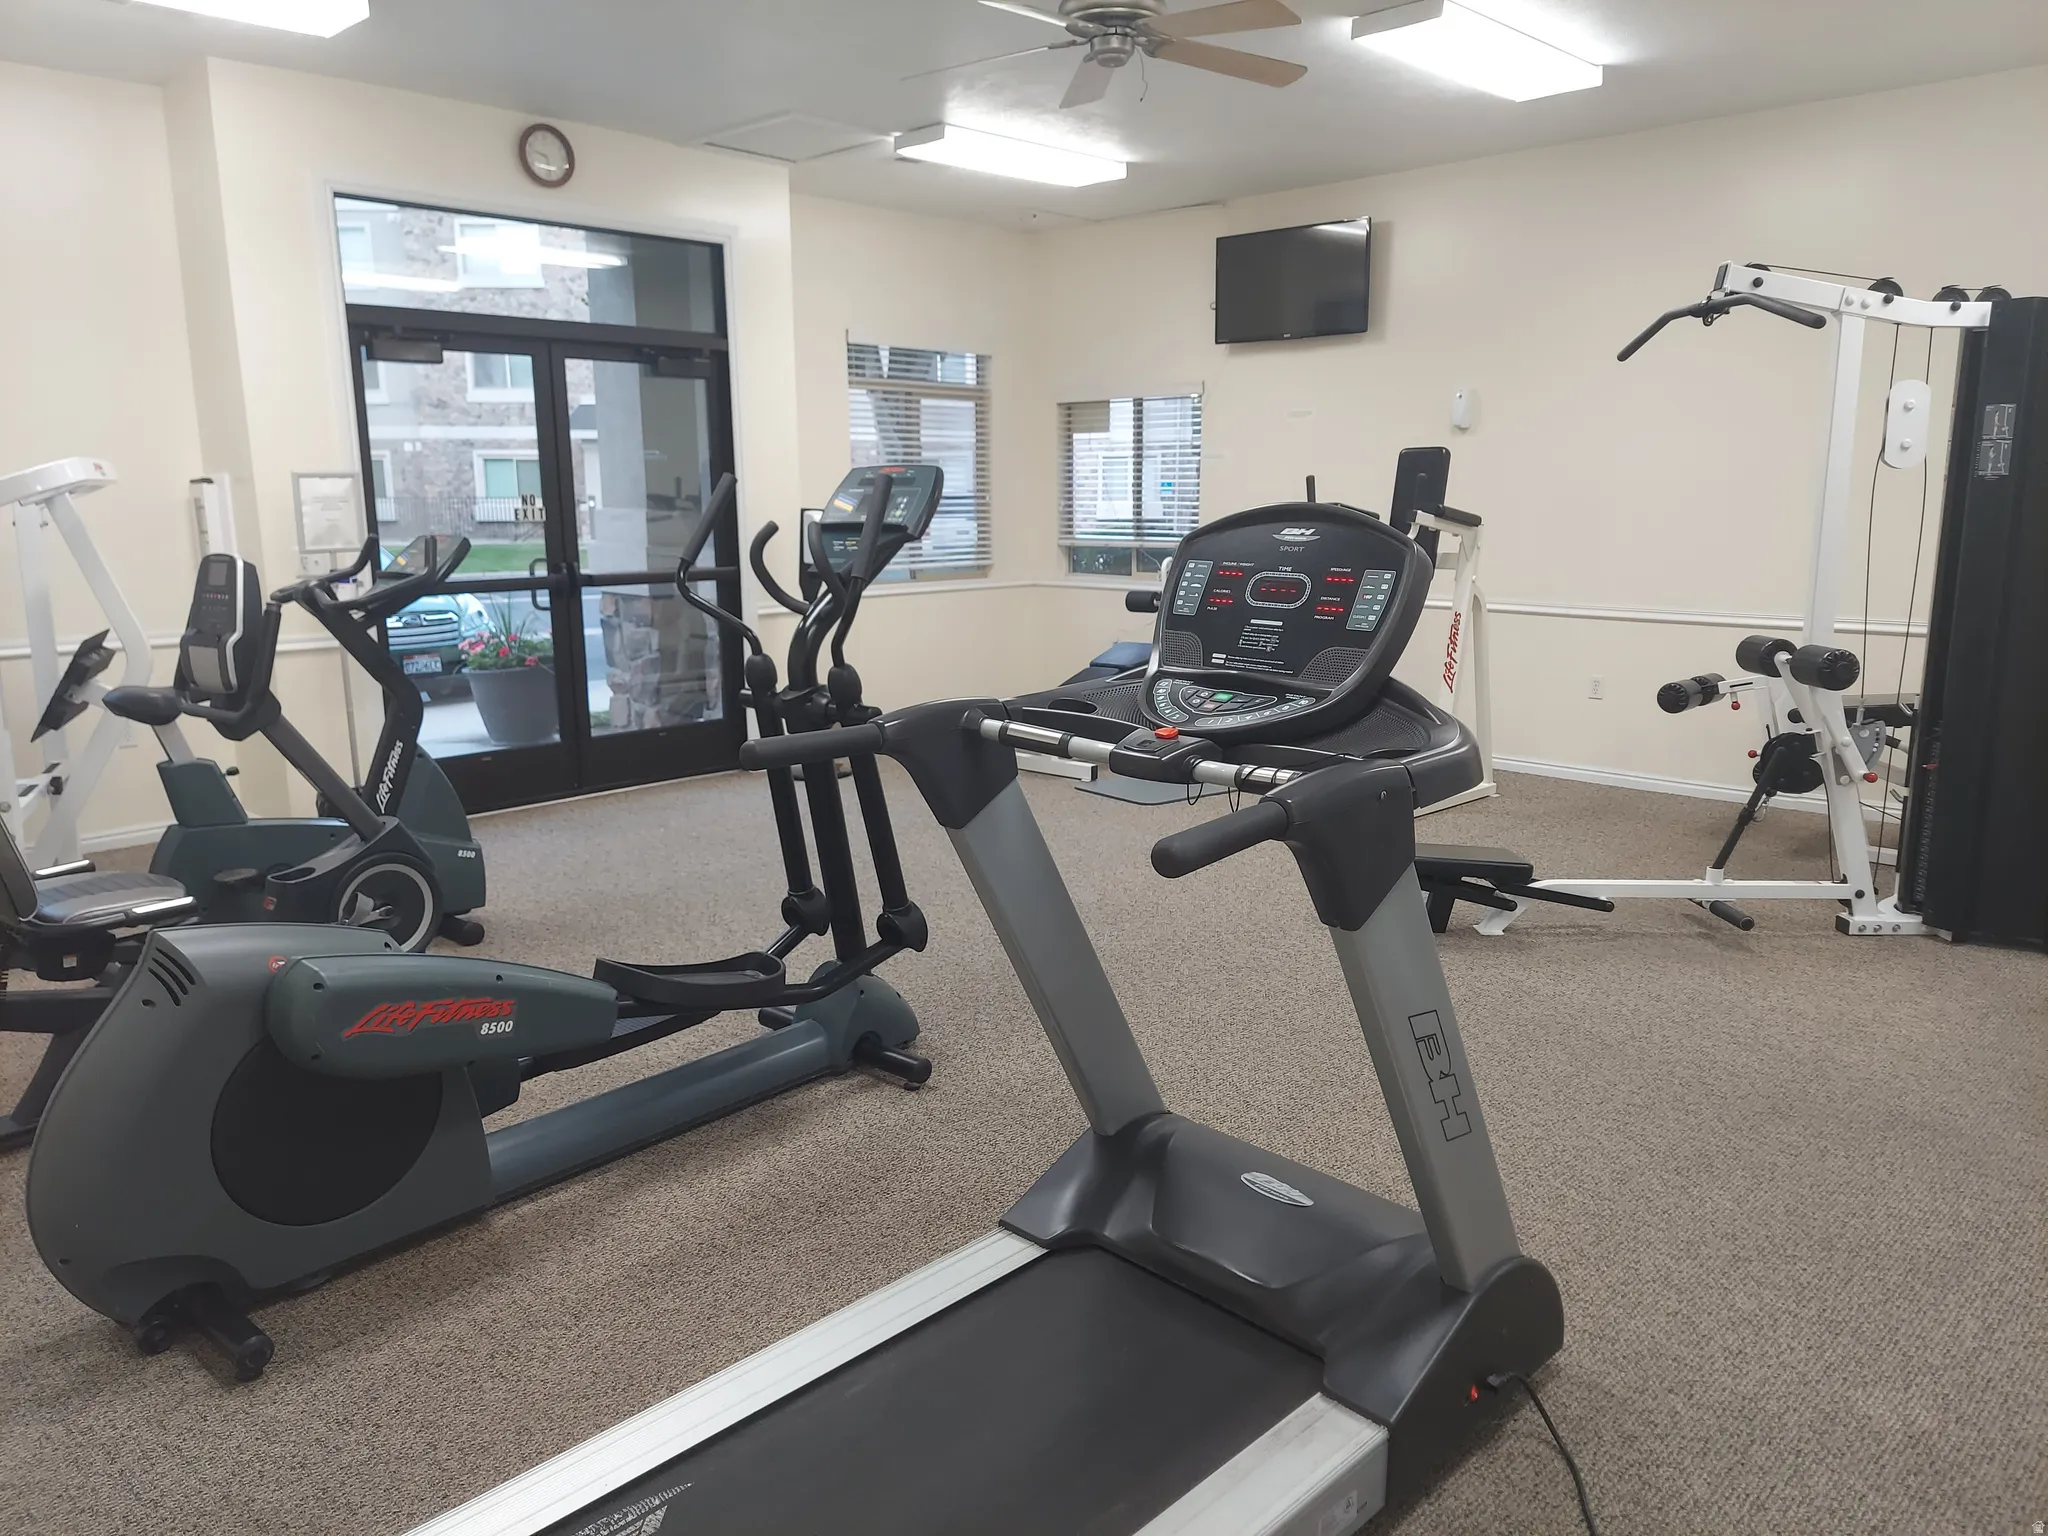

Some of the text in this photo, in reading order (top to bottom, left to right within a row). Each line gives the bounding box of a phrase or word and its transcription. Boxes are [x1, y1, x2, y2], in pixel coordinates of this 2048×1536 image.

[521, 494, 536, 506] NO
[514, 508, 544, 520] EXIT
[457, 849, 476, 858] 8500
[480, 1020, 514, 1036] 8500
[1408, 1010, 1472, 1142] BH
